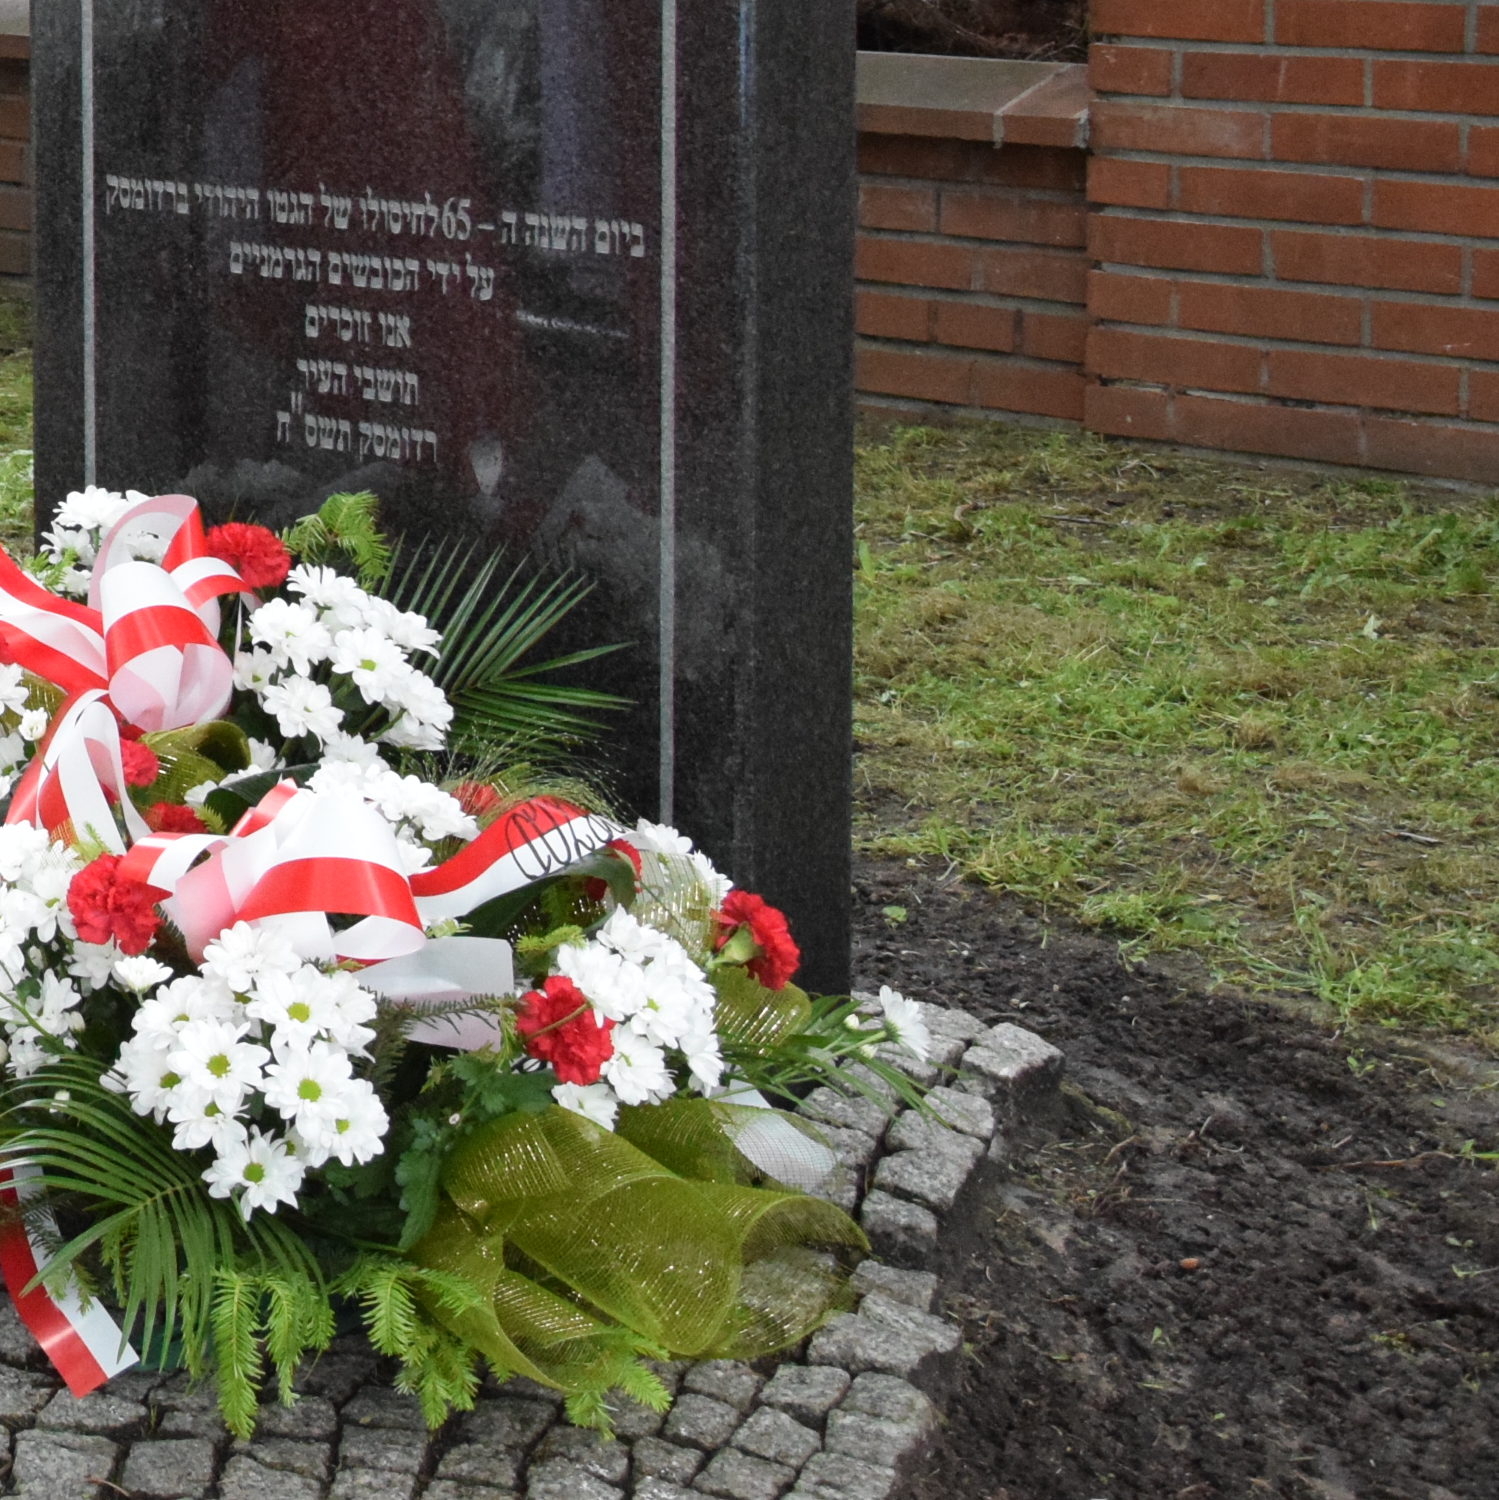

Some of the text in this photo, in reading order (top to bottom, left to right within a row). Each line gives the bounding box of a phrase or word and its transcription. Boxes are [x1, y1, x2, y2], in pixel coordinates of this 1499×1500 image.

[106, 174, 190, 215] ברדומסק
[194, 182, 259, 219] היהודי
[267, 190, 313, 224] הגטו
[319, 181, 351, 229] של
[524, 213, 589, 251] השנה
[595, 219, 645, 257] ביום
[229, 241, 495, 300] על ידי הכובשים הגרמניים
[305, 304, 411, 348] אנו זוכרים
[296, 359, 418, 405] תושבי העיר
[358, 421, 437, 463] רדומסק
